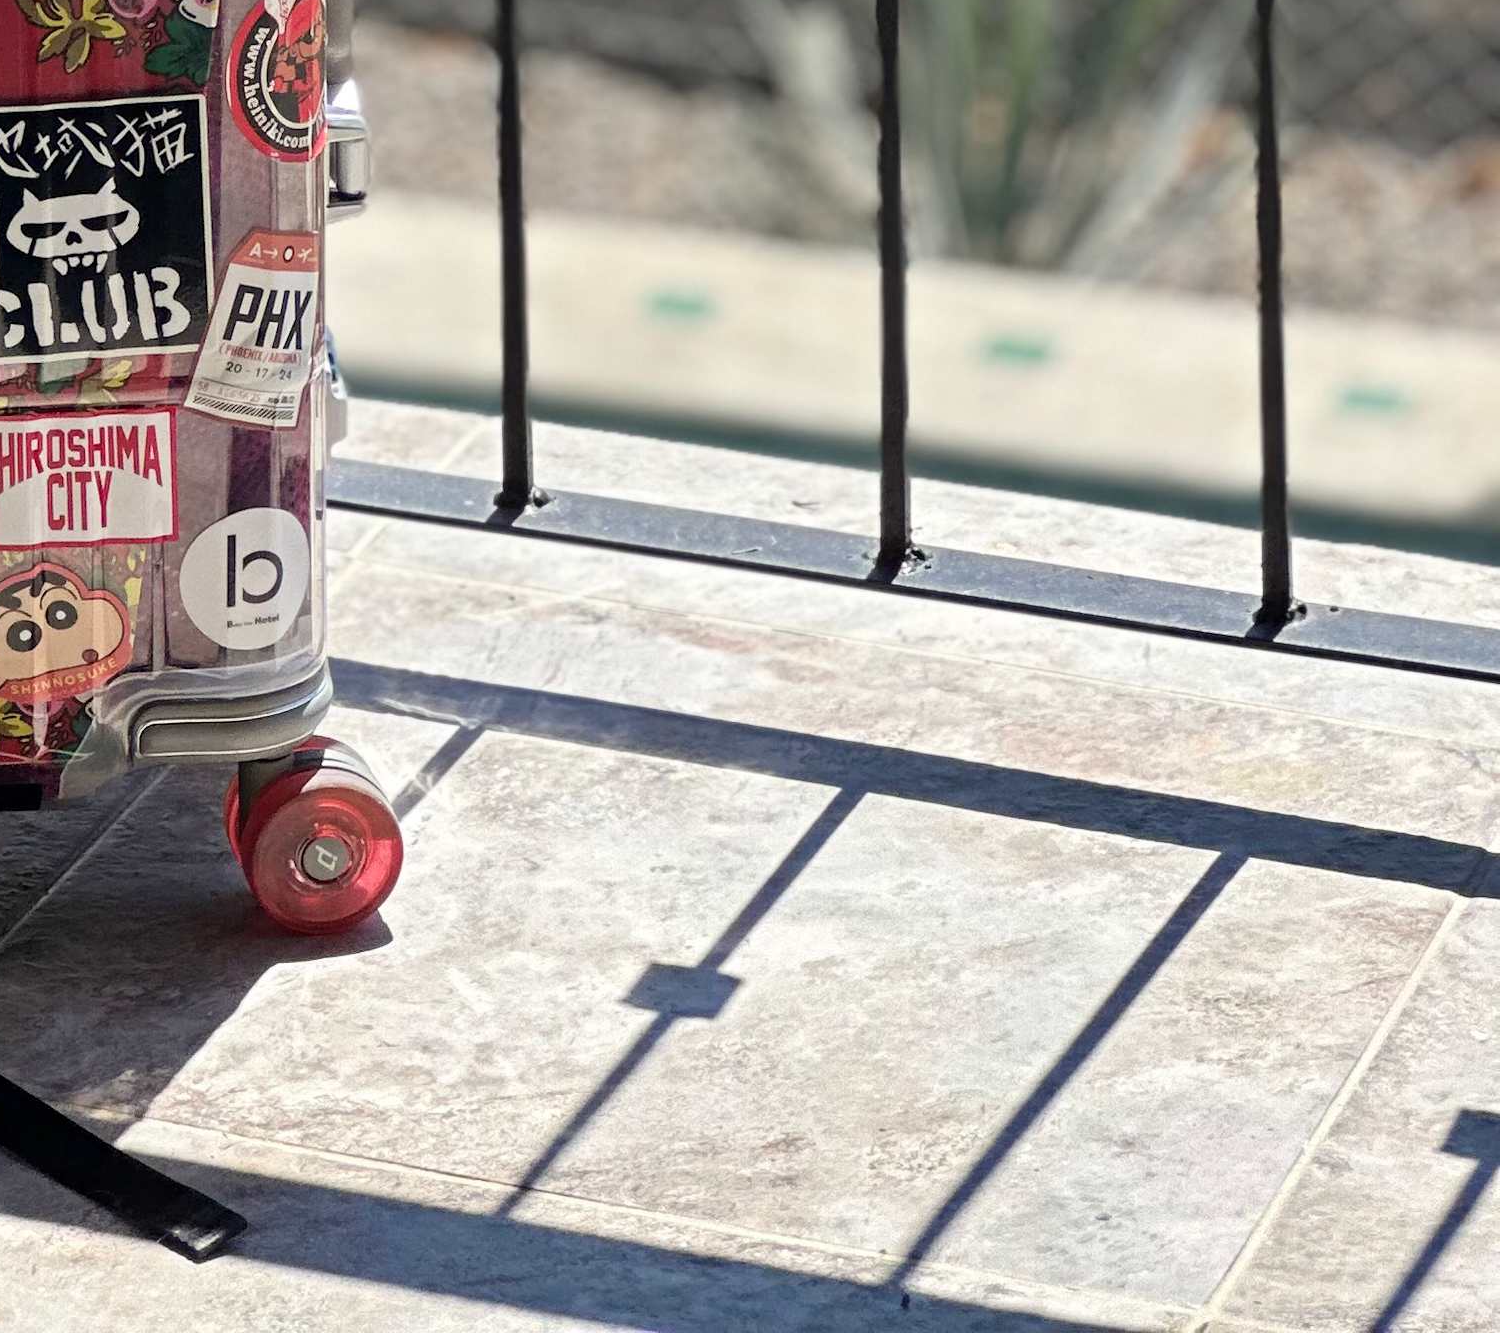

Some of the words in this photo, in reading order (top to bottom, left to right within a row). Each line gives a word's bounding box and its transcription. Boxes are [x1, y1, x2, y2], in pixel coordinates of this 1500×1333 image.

[223, 284, 313, 350] PHX
[47, 471, 113, 531] CITY
[10, 657, 117, 695] SHINNOSUKE
